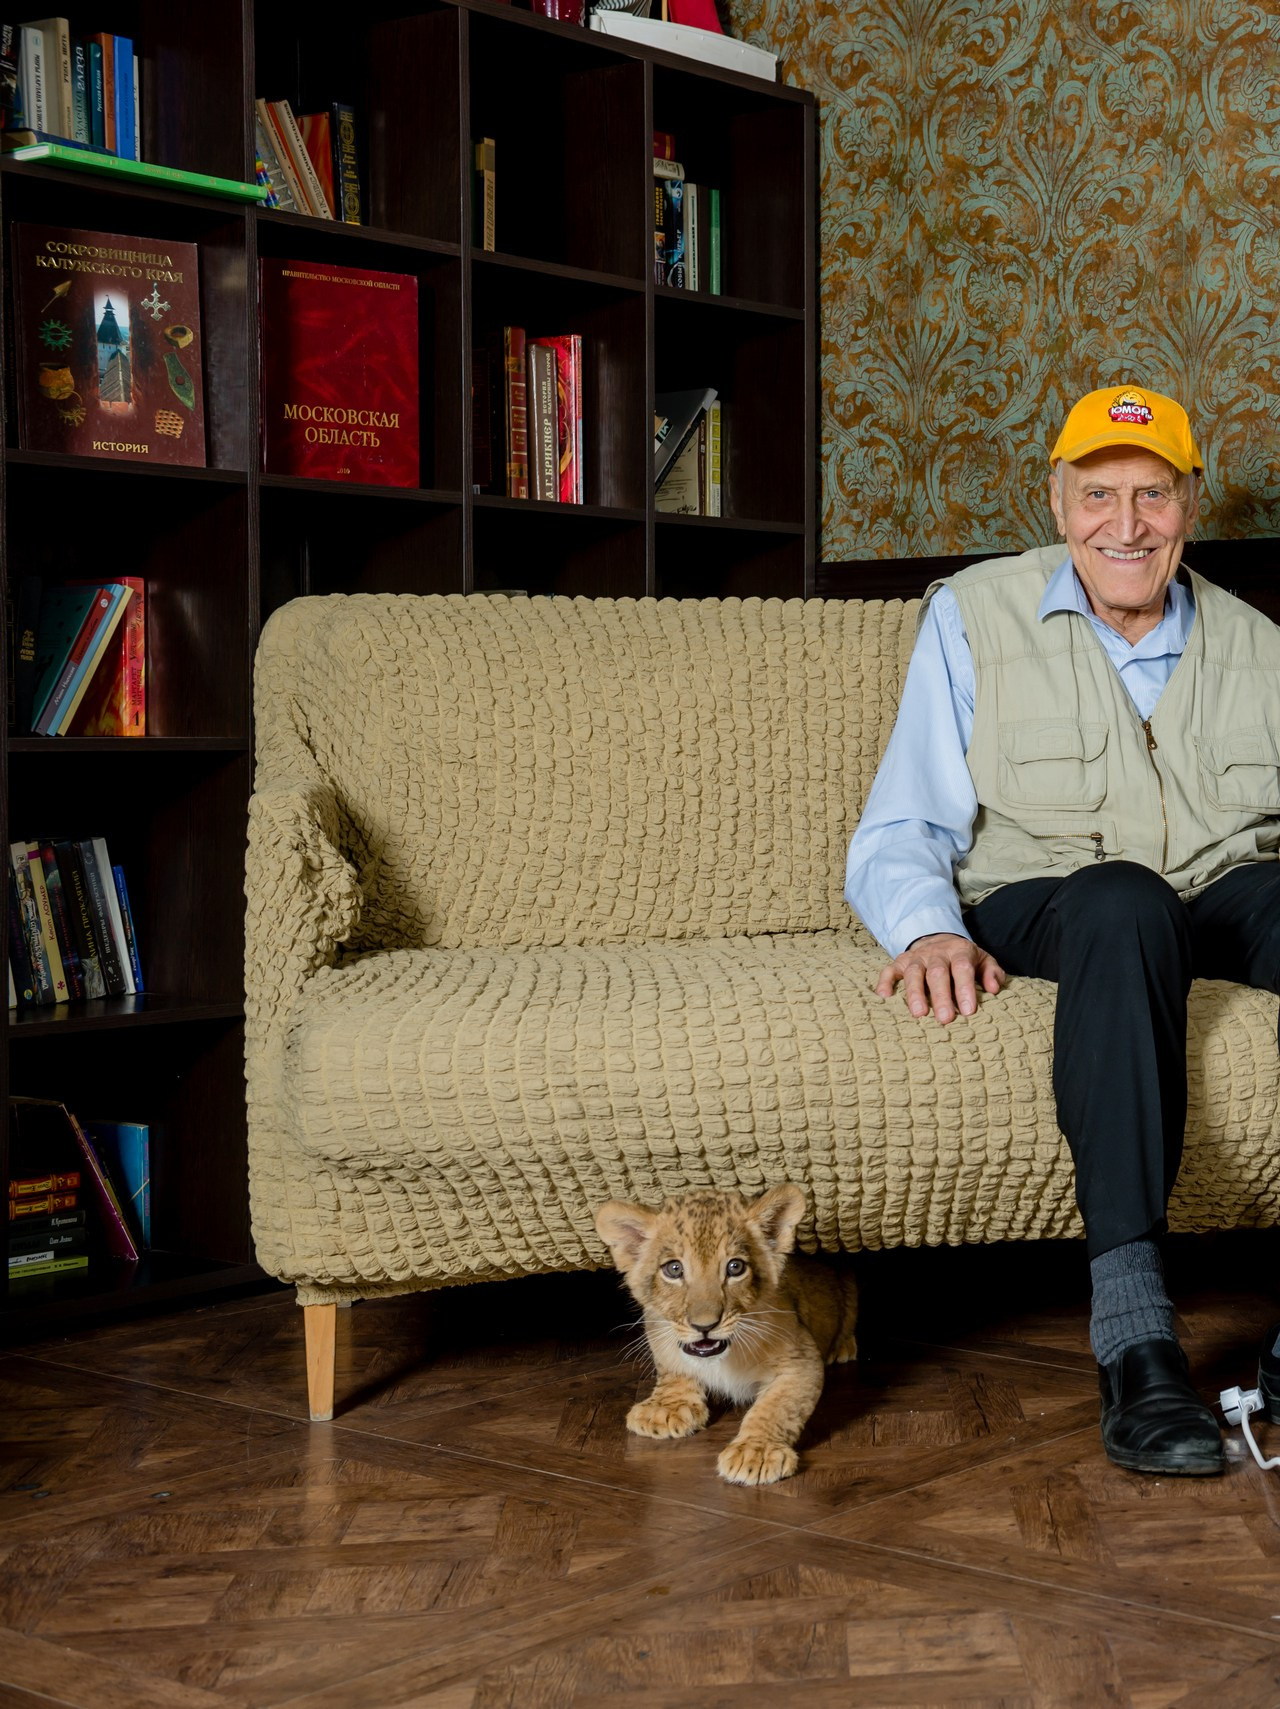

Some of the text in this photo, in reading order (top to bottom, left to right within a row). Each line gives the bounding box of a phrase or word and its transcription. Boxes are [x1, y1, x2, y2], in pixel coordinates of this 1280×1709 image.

[45, 240, 173, 268] СОКРОВИЩНИЦА
[35, 255, 184, 284] КАЛУЖСКОГО КРАЯ
[282, 270, 400, 291] ПРАВИТЕЛЬСТВО МОСКОВСКОЙ ОБЛАСТИ
[283, 403, 400, 429] МОСКОВСКАЯ
[92, 440, 149, 454] ИСТОРИЯ
[304, 427, 381, 448] ОБЛАСТЬ
